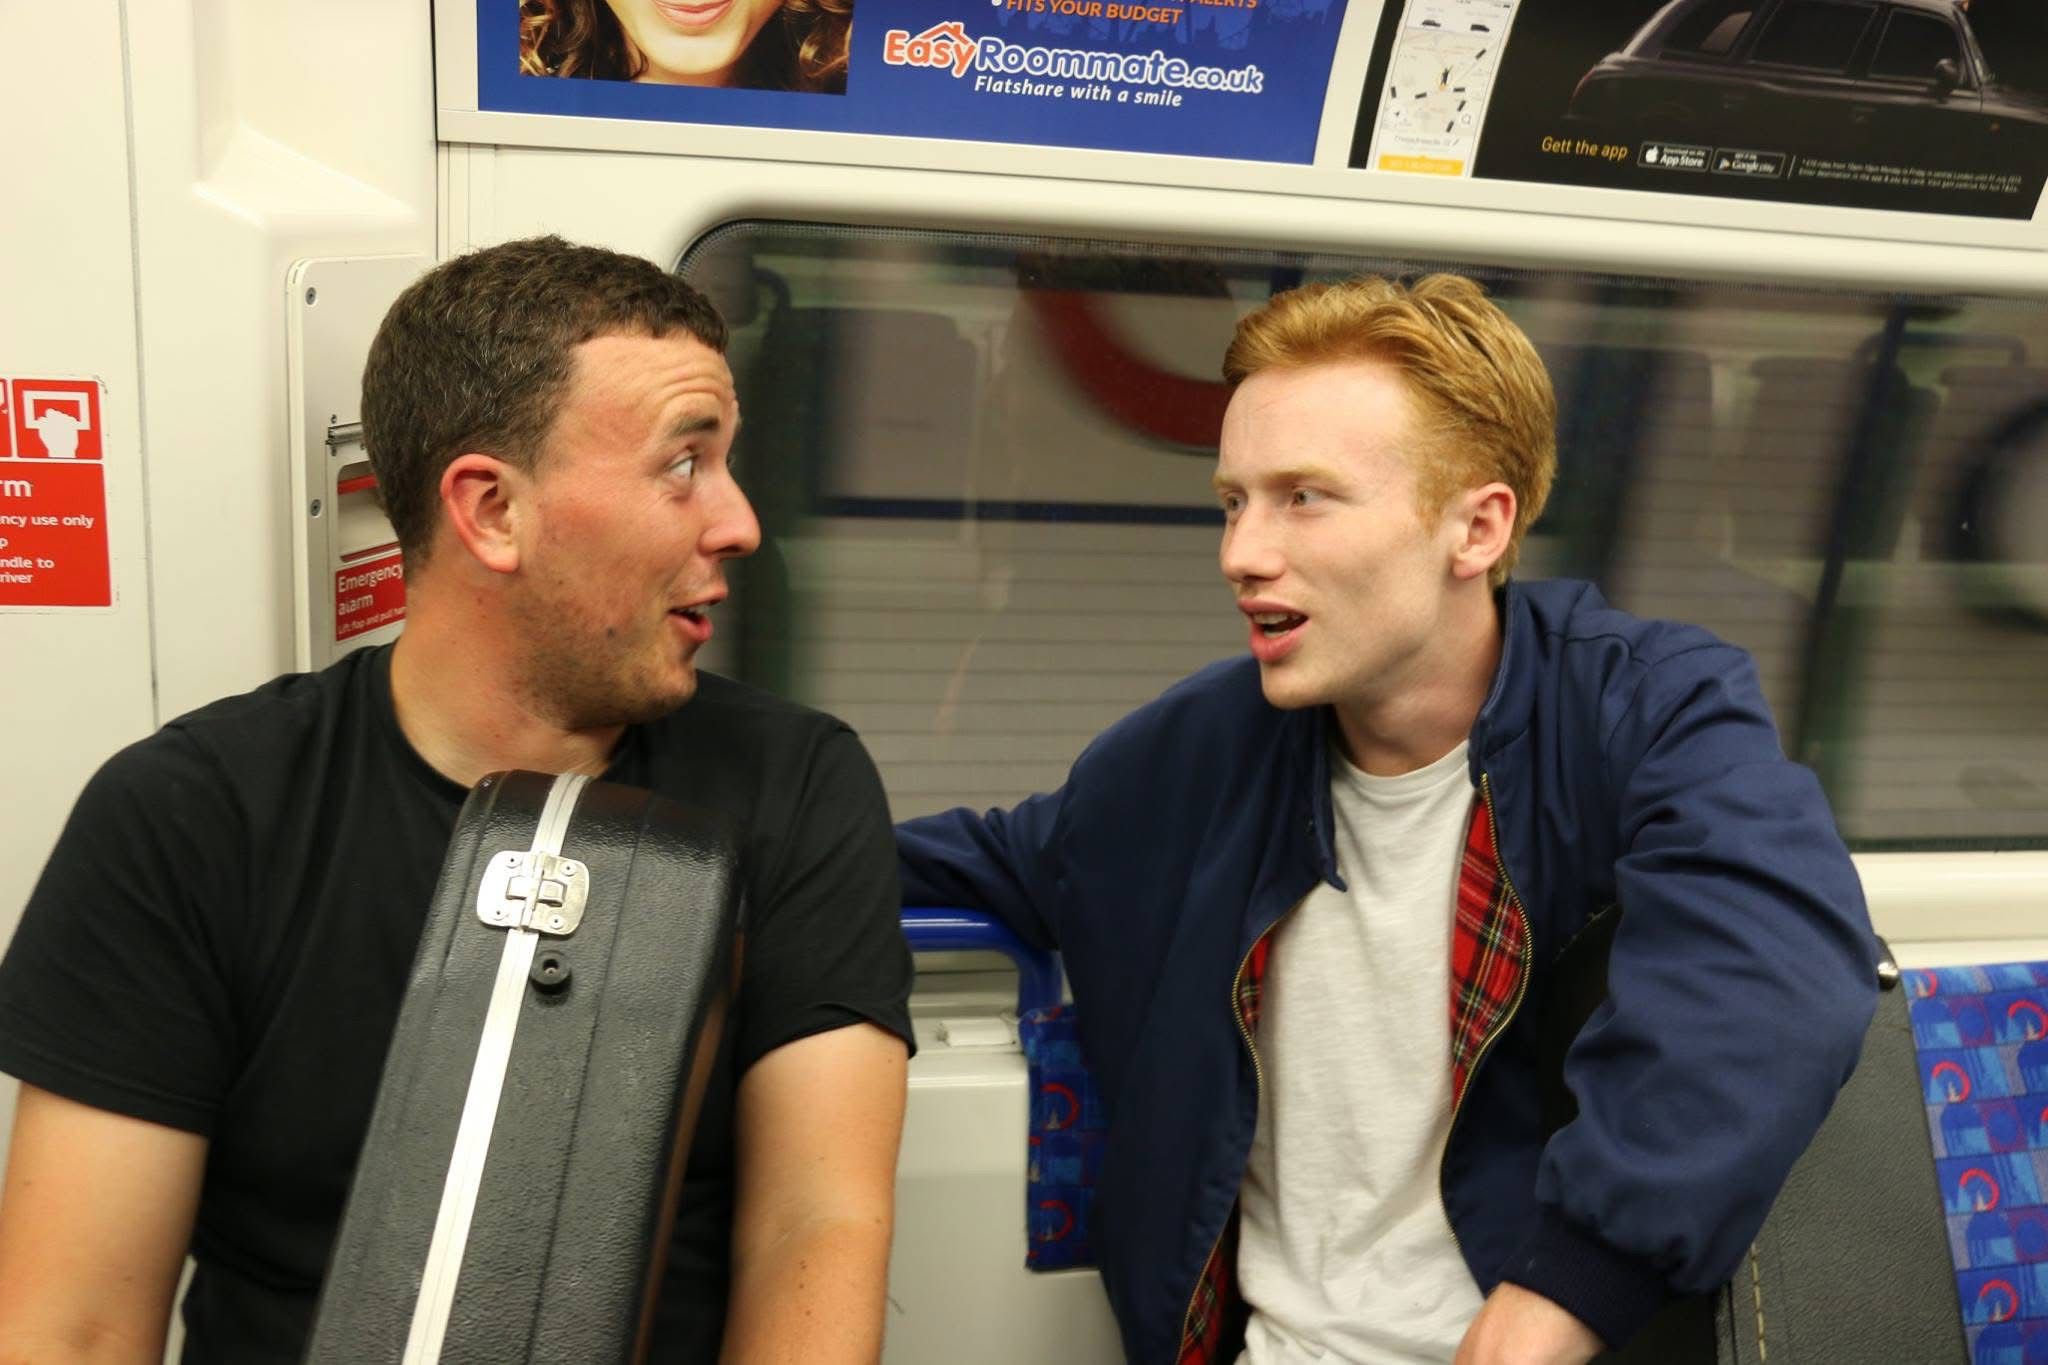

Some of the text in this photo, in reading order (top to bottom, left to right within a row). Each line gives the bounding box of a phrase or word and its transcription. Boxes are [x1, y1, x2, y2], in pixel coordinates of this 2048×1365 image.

[1051, 0, 1102, 17] YOUR
[1106, 5, 1184, 25] BUDGET
[974, 75, 1183, 108] Flatshare with a smile
[1541, 136, 1629, 161] Gett the app
[1659, 154, 1704, 168] App Store
[31, 515, 59, 526] use
[62, 514, 95, 529] only
[36, 557, 55, 569] to
[338, 594, 374, 616] alarm
